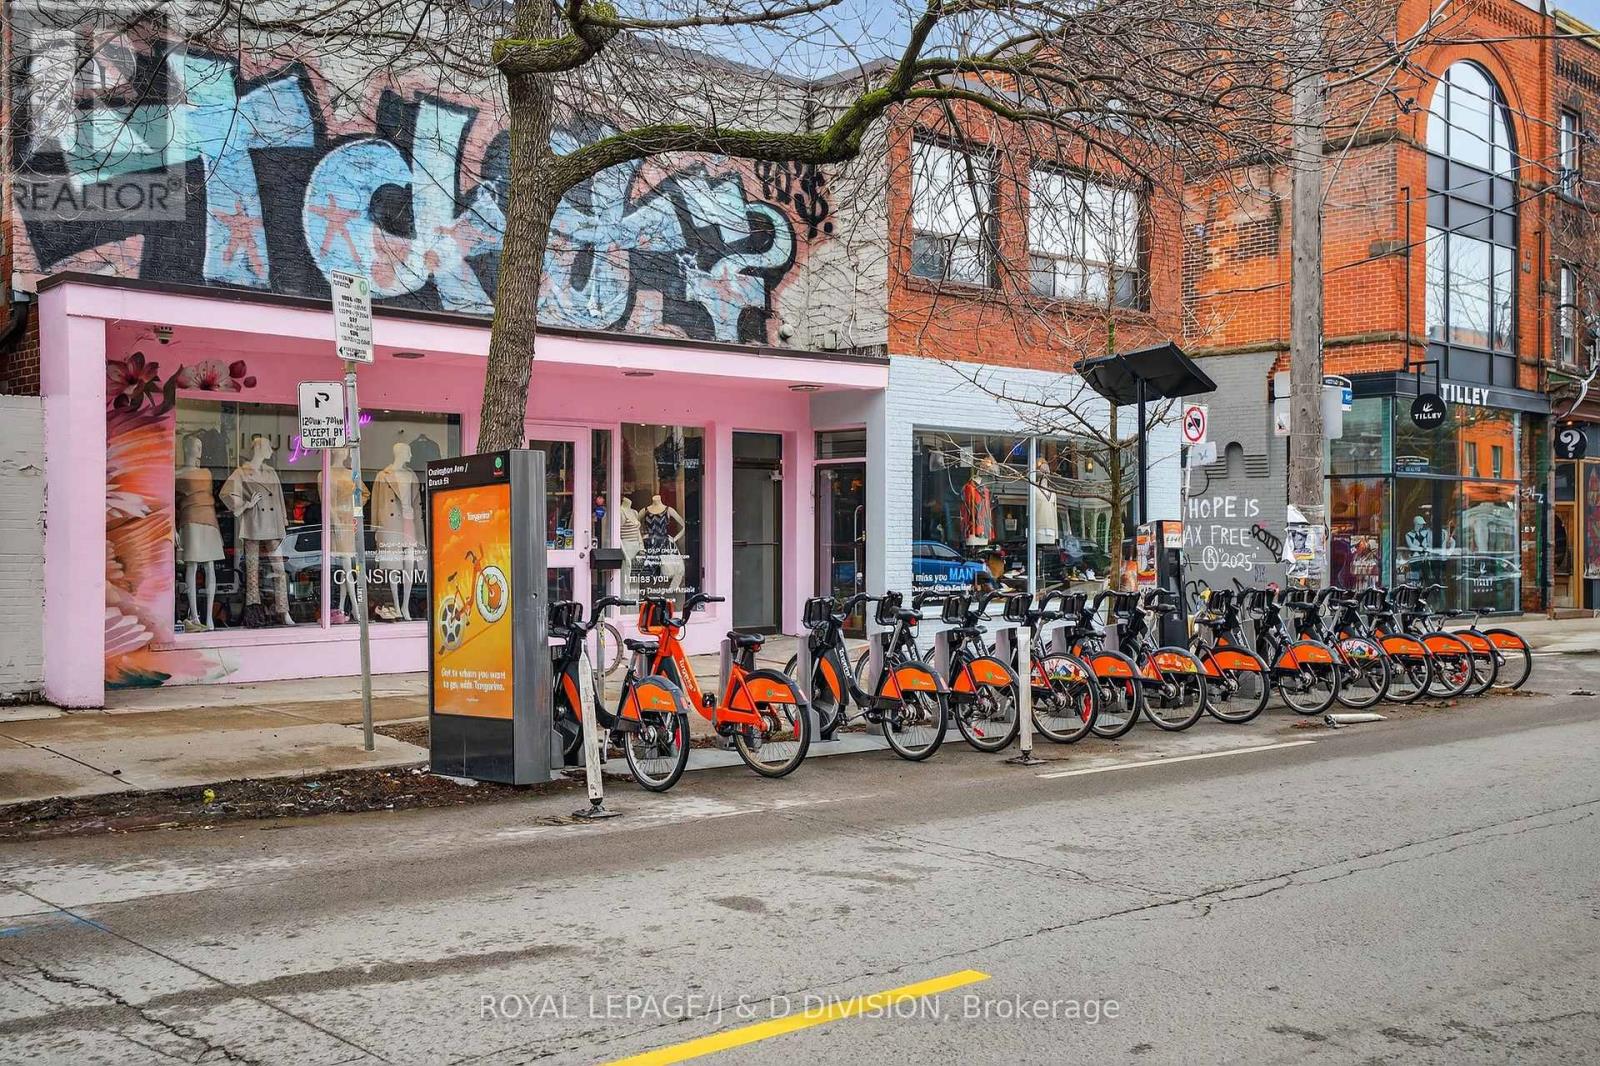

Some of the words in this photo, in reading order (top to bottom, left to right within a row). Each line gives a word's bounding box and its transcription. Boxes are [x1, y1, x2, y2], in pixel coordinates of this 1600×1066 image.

[1441, 383, 1489, 406] TILLEY
[1414, 412, 1442, 420] TILLEY
[302, 428, 330, 437] EXCEPT
[333, 427, 344, 437] BY
[310, 438, 337, 447] PERMIT
[1188, 496, 1237, 519] HOPE
[1244, 498, 1260, 518] IS
[1183, 525, 1202, 547] AX
[652, 575, 669, 585] you
[949, 567, 974, 581] MAN
